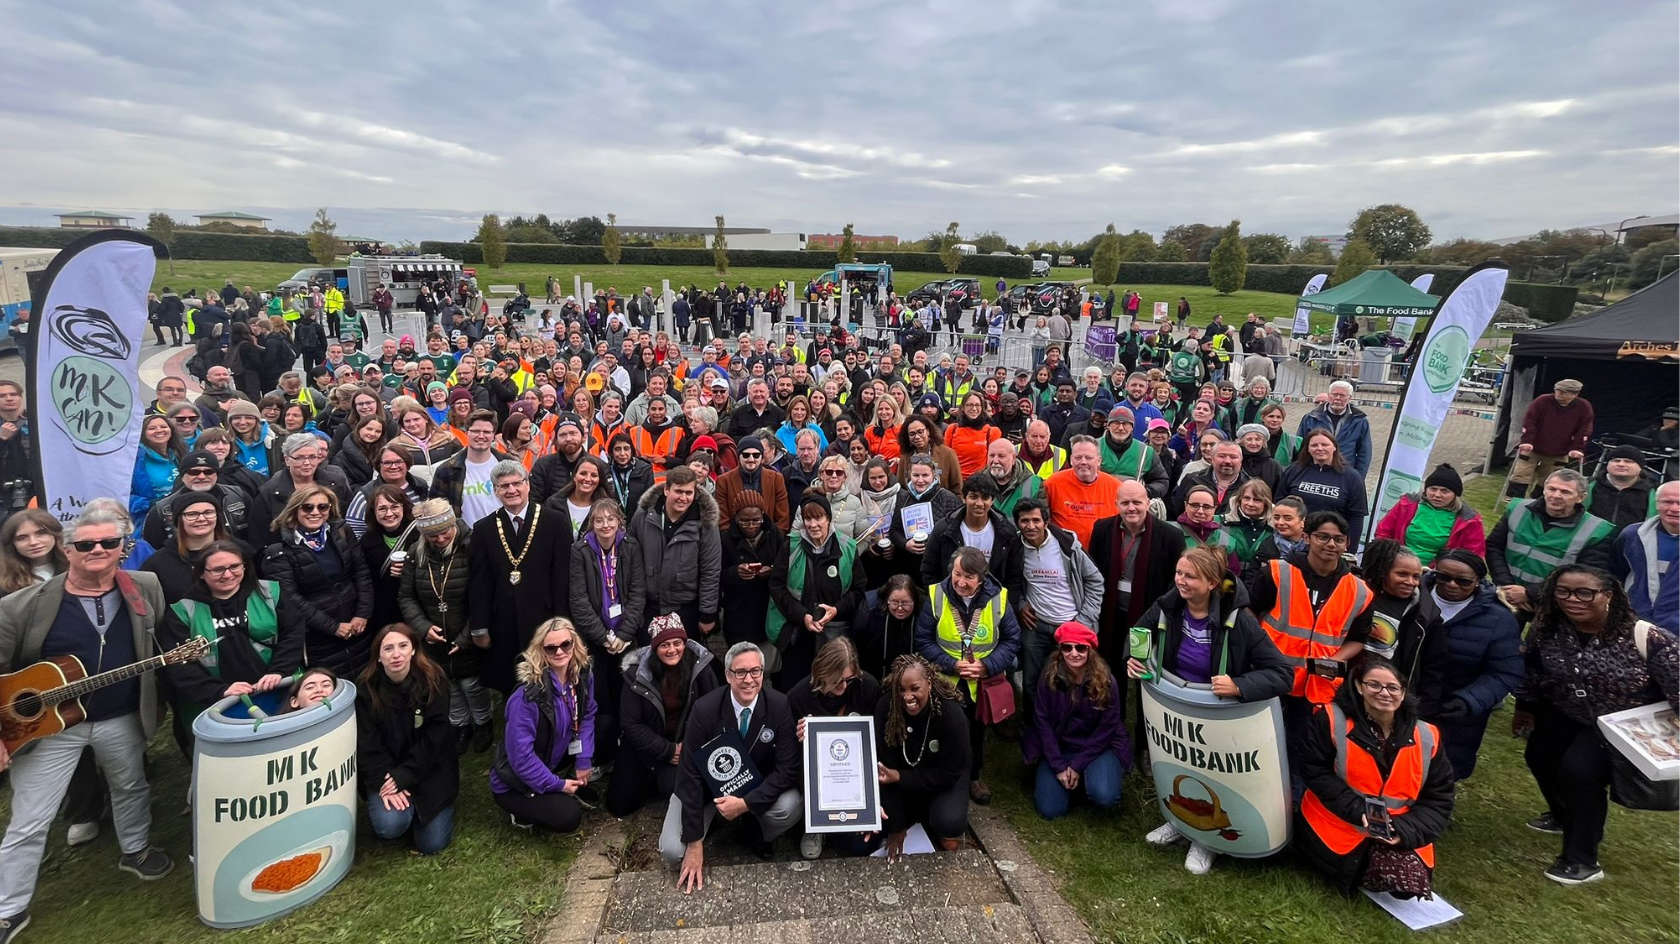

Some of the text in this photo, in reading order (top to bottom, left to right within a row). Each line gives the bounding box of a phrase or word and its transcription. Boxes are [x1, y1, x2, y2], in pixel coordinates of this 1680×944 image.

[1368, 306, 1434, 316] The Food Bank
[1618, 340, 1672, 352] Arches
[1298, 482, 1340, 497] FREETHS
[1163, 711, 1208, 746] MK
[1145, 717, 1261, 774] FOODBANK
[266, 746, 319, 786] MK
[719, 768, 750, 792] OFFICIALLY
[723, 773, 754, 797] AMAZING
[214, 790, 289, 823] FOOD
